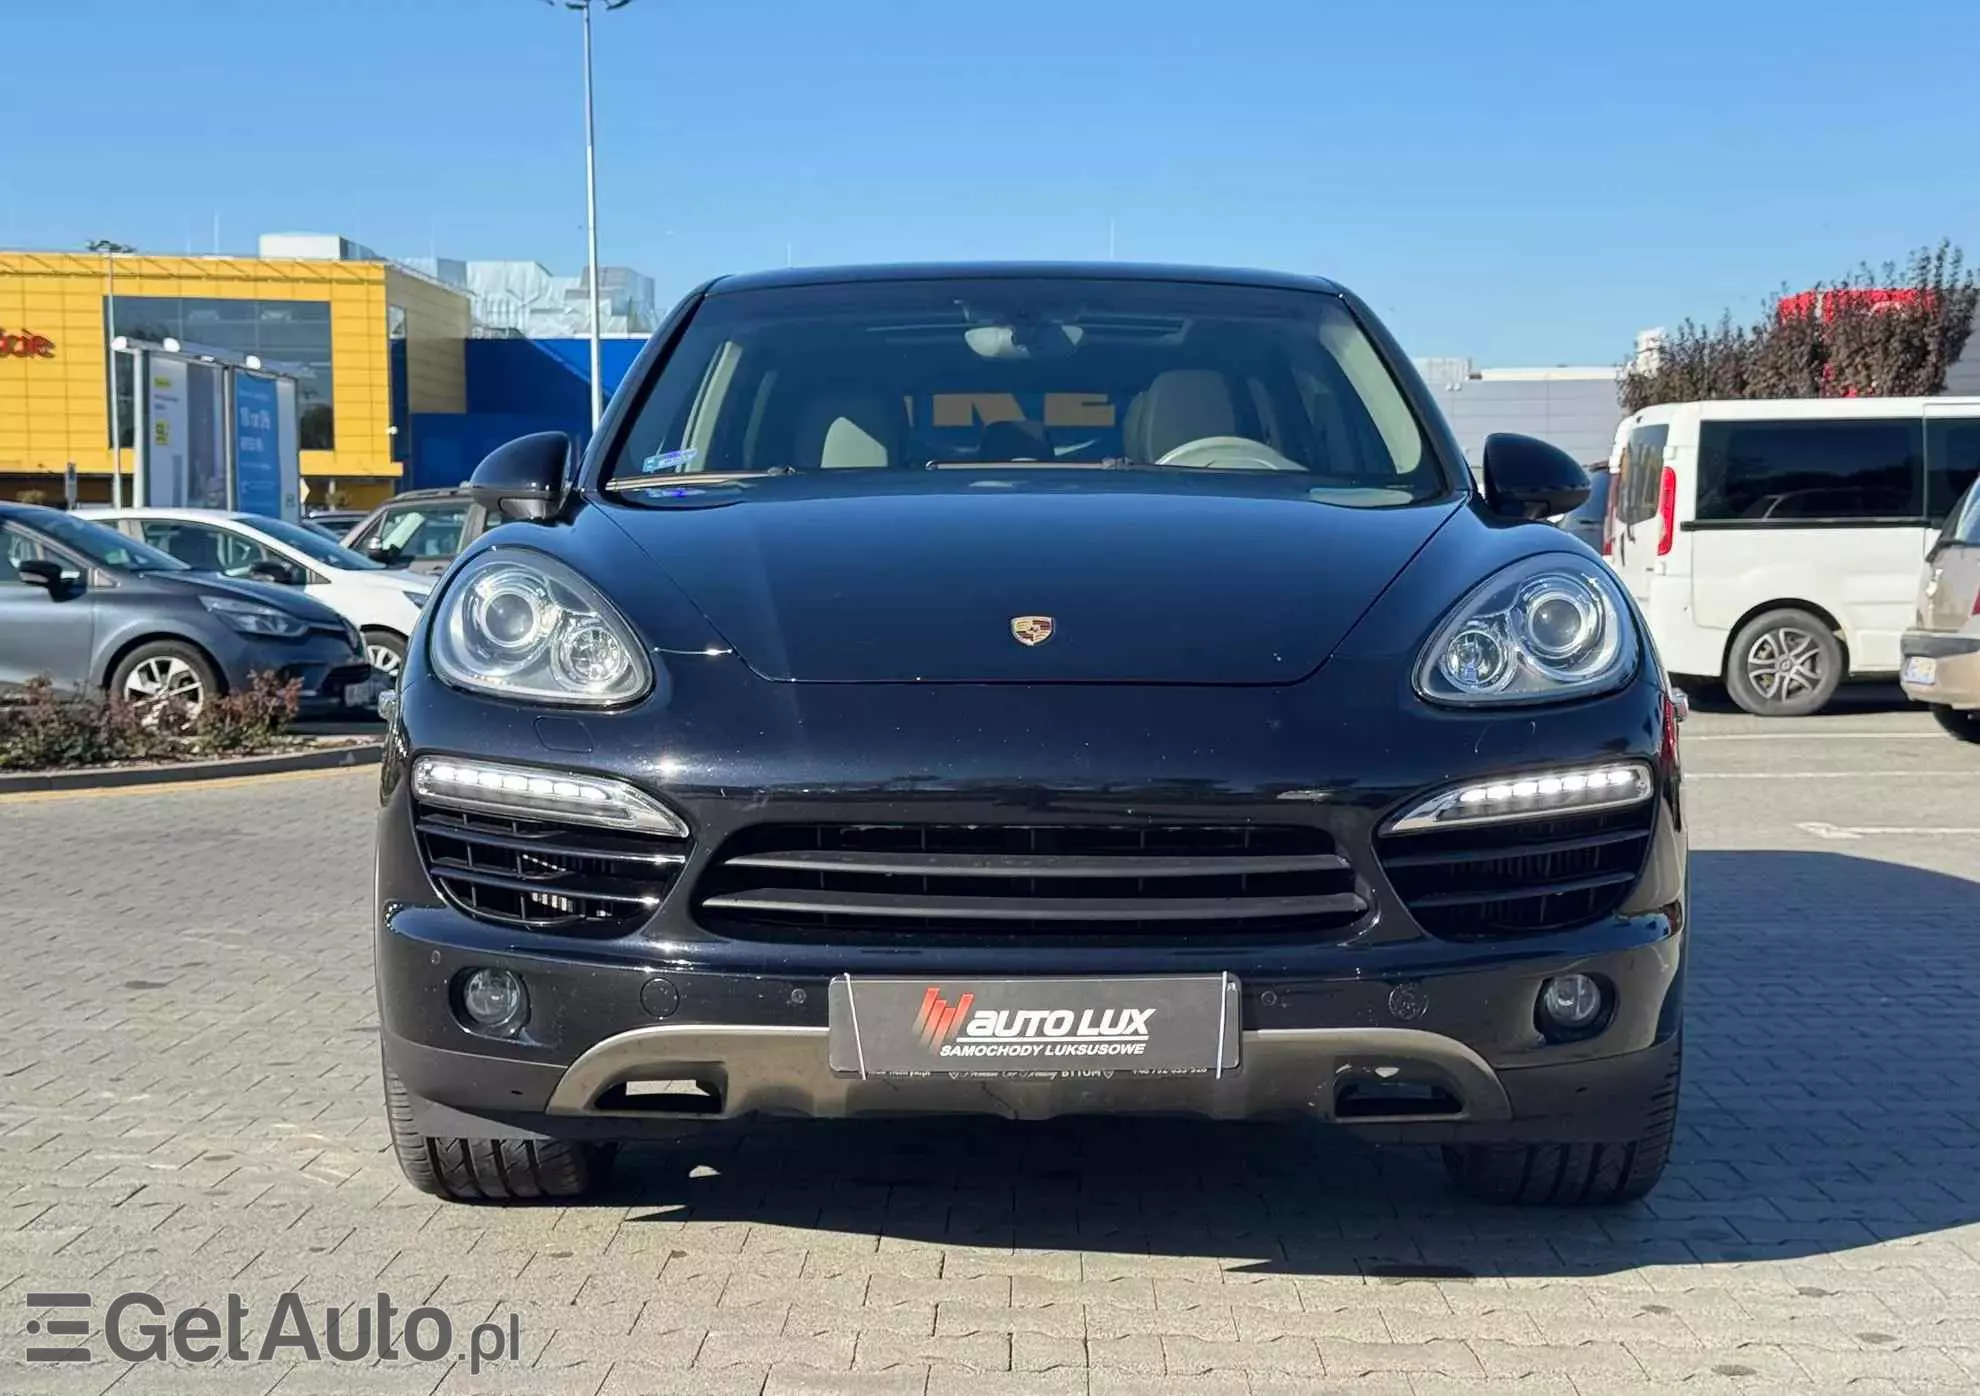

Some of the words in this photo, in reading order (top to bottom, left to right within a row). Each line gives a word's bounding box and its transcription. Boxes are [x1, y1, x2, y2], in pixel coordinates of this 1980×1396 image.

[1076, 1008, 1156, 1036] LUX
[940, 1045, 1043, 1057] SAMOCHODY
[1045, 1043, 1147, 1056] LUKSUSOWE
